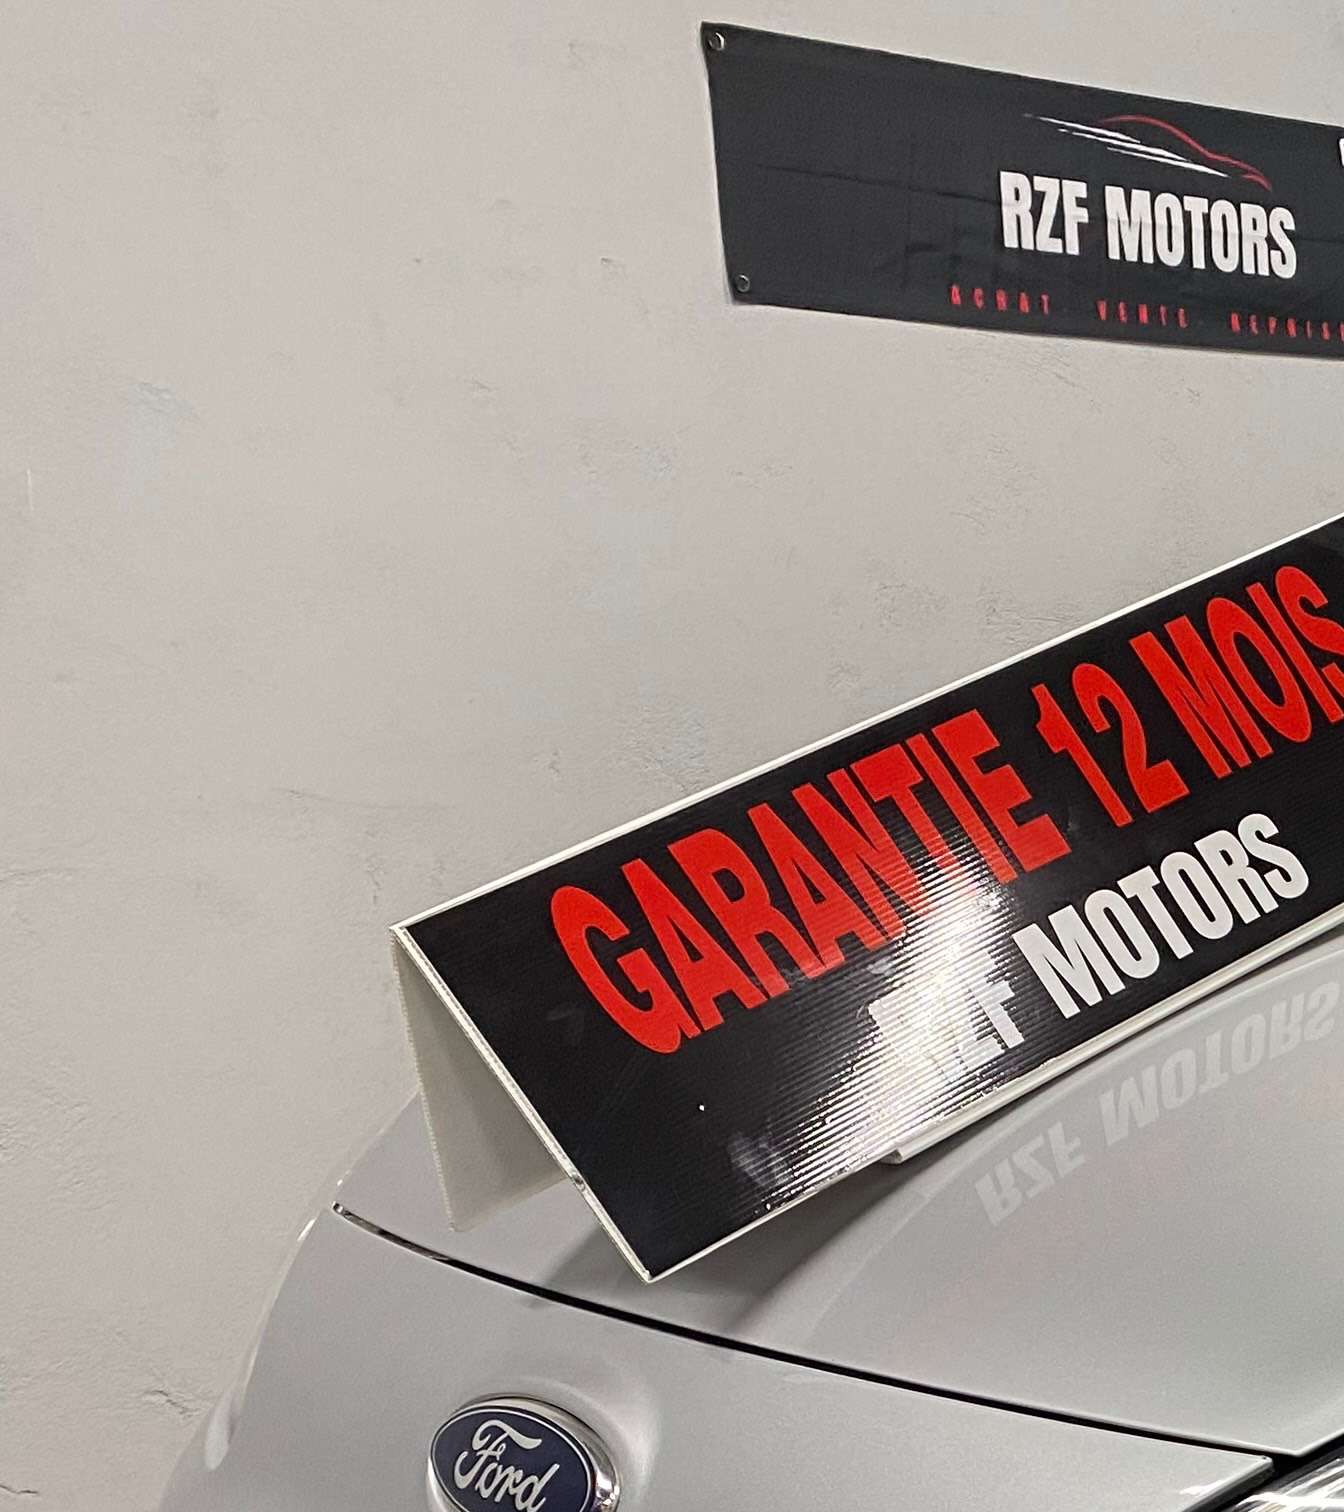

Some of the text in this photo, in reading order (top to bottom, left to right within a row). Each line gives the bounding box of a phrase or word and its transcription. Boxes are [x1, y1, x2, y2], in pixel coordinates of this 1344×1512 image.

[1000, 170, 1297, 279] RZF MOTORS
[550, 708, 1072, 1054] GARANTIE
[1032, 661, 1189, 829] 12
[1012, 811, 1310, 1022] MOTORS
